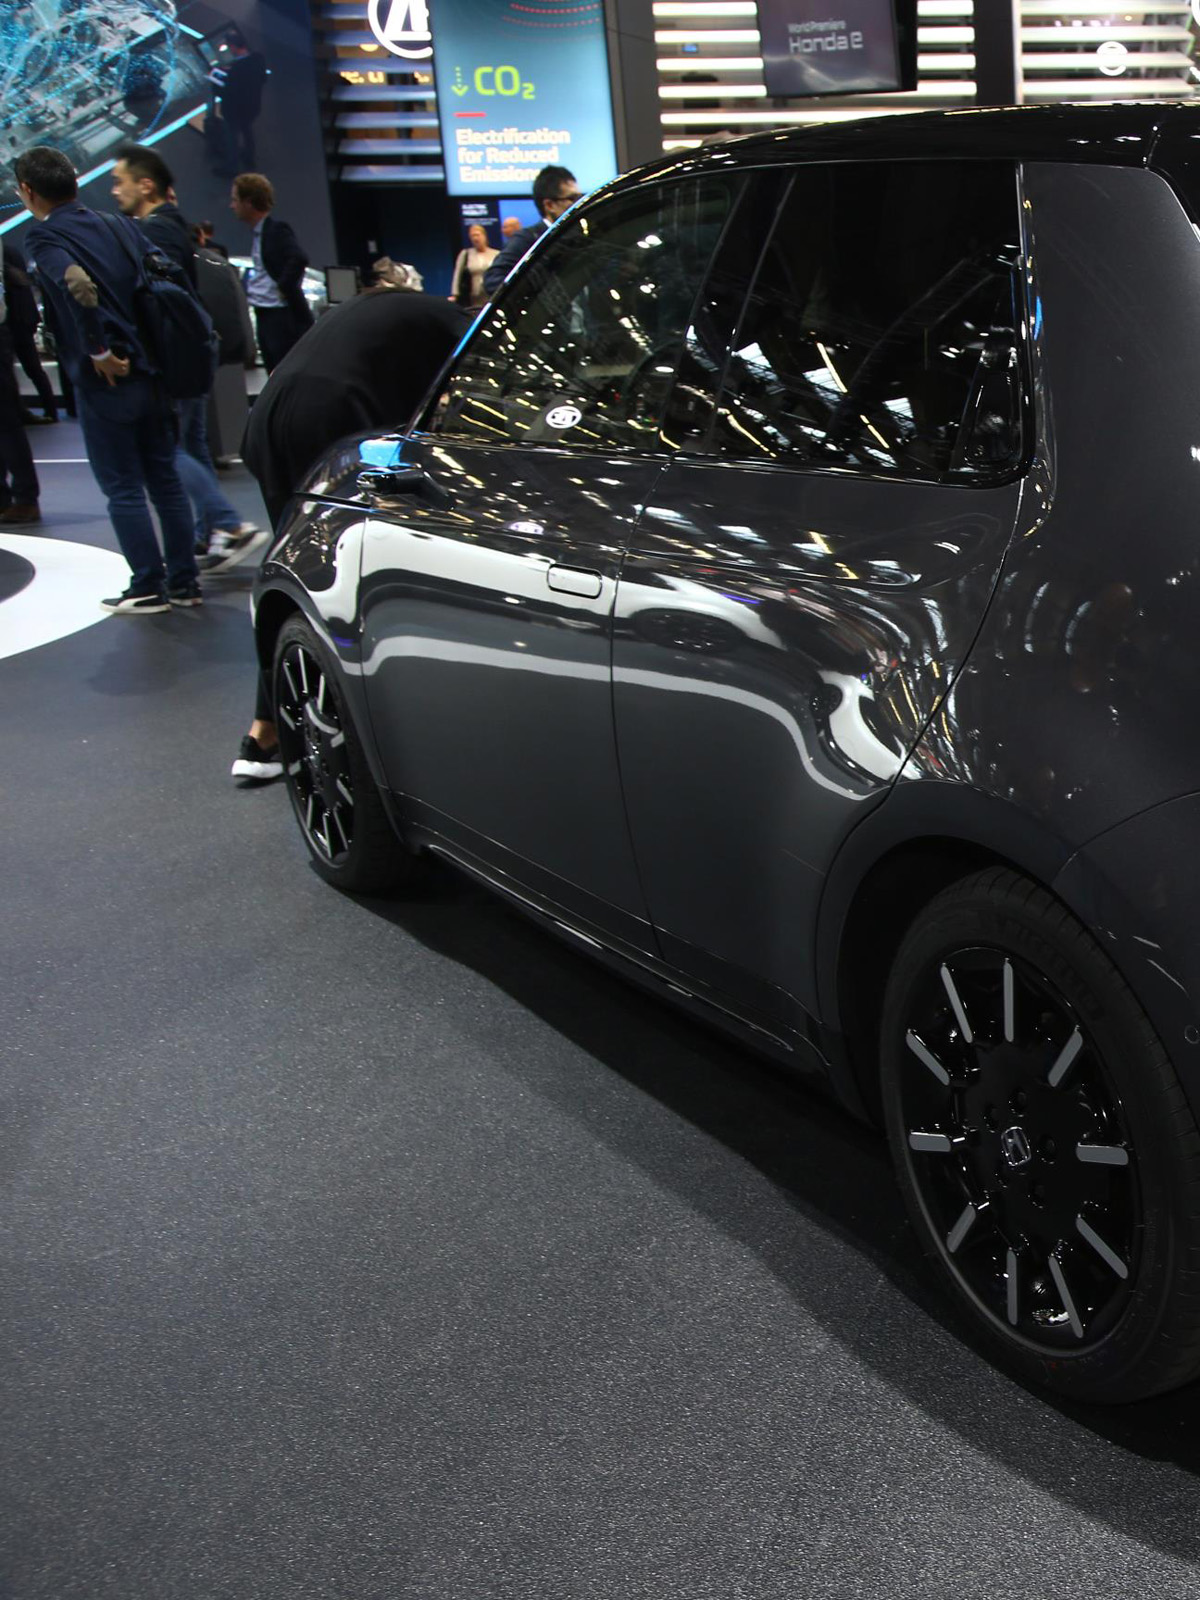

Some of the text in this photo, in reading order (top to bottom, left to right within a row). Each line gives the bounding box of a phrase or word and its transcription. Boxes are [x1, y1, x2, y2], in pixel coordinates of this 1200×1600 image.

[789, 31, 863, 53] Honda e
[456, 128, 571, 145] Electrification
[458, 147, 559, 163] for Reduced
